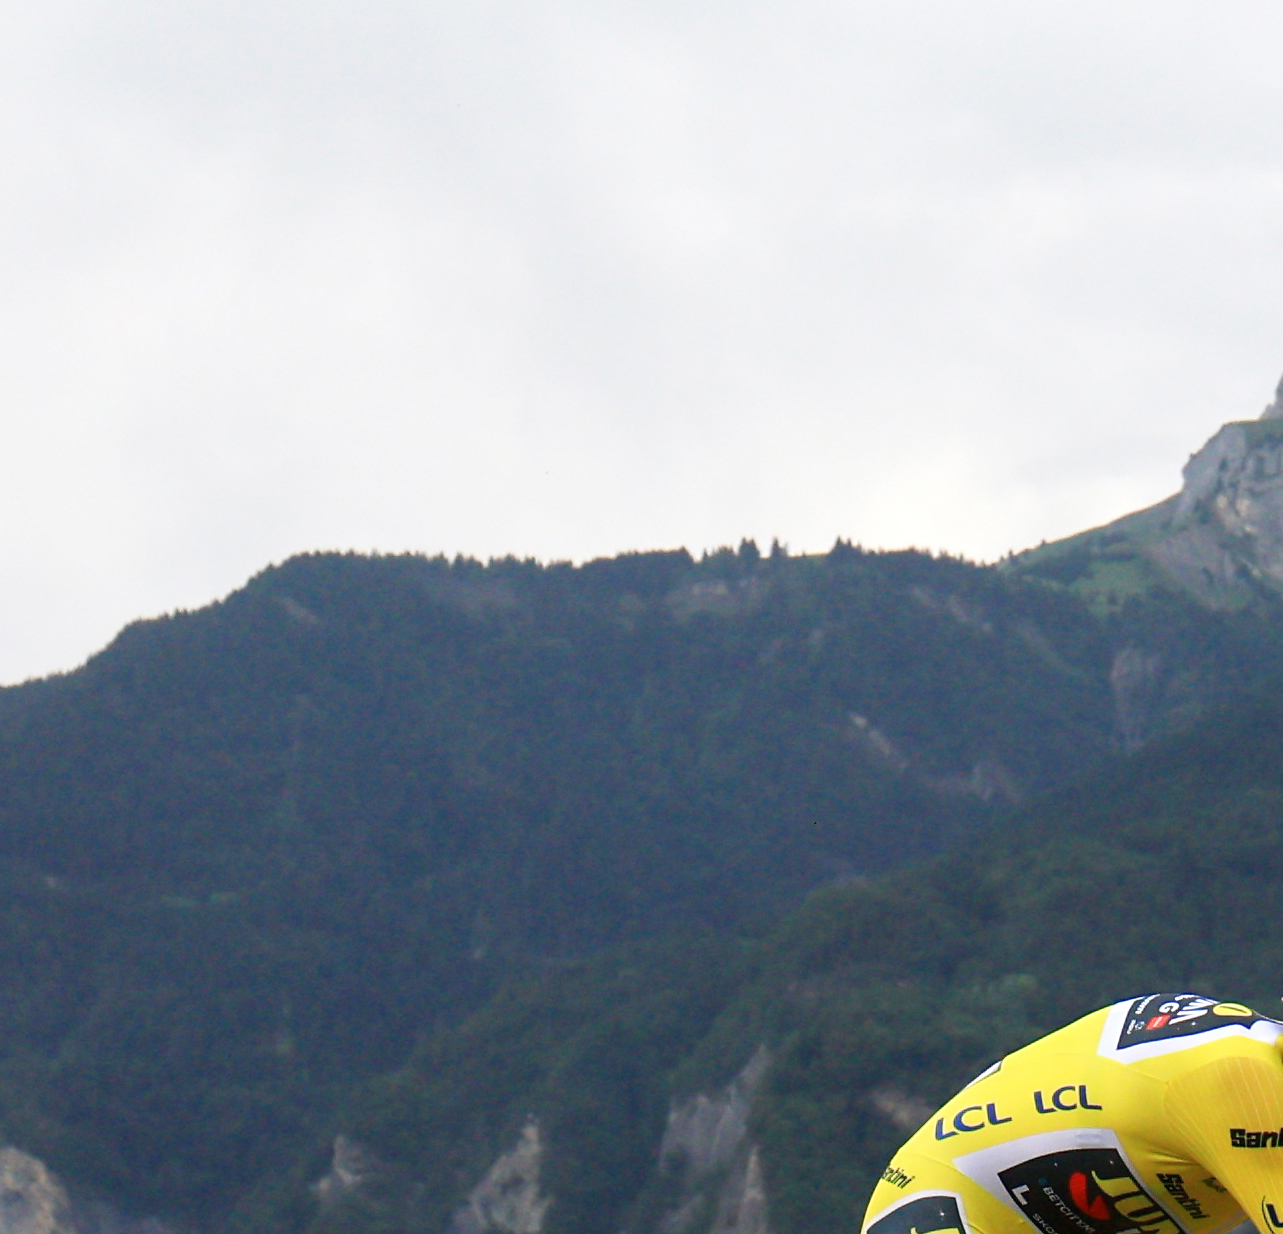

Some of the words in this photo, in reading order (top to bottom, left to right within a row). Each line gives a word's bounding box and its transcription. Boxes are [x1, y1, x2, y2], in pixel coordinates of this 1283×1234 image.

[1034, 1085, 1103, 1114] LCL
[935, 1103, 1013, 1140] LCL
[1156, 1173, 1211, 1229] Santini
